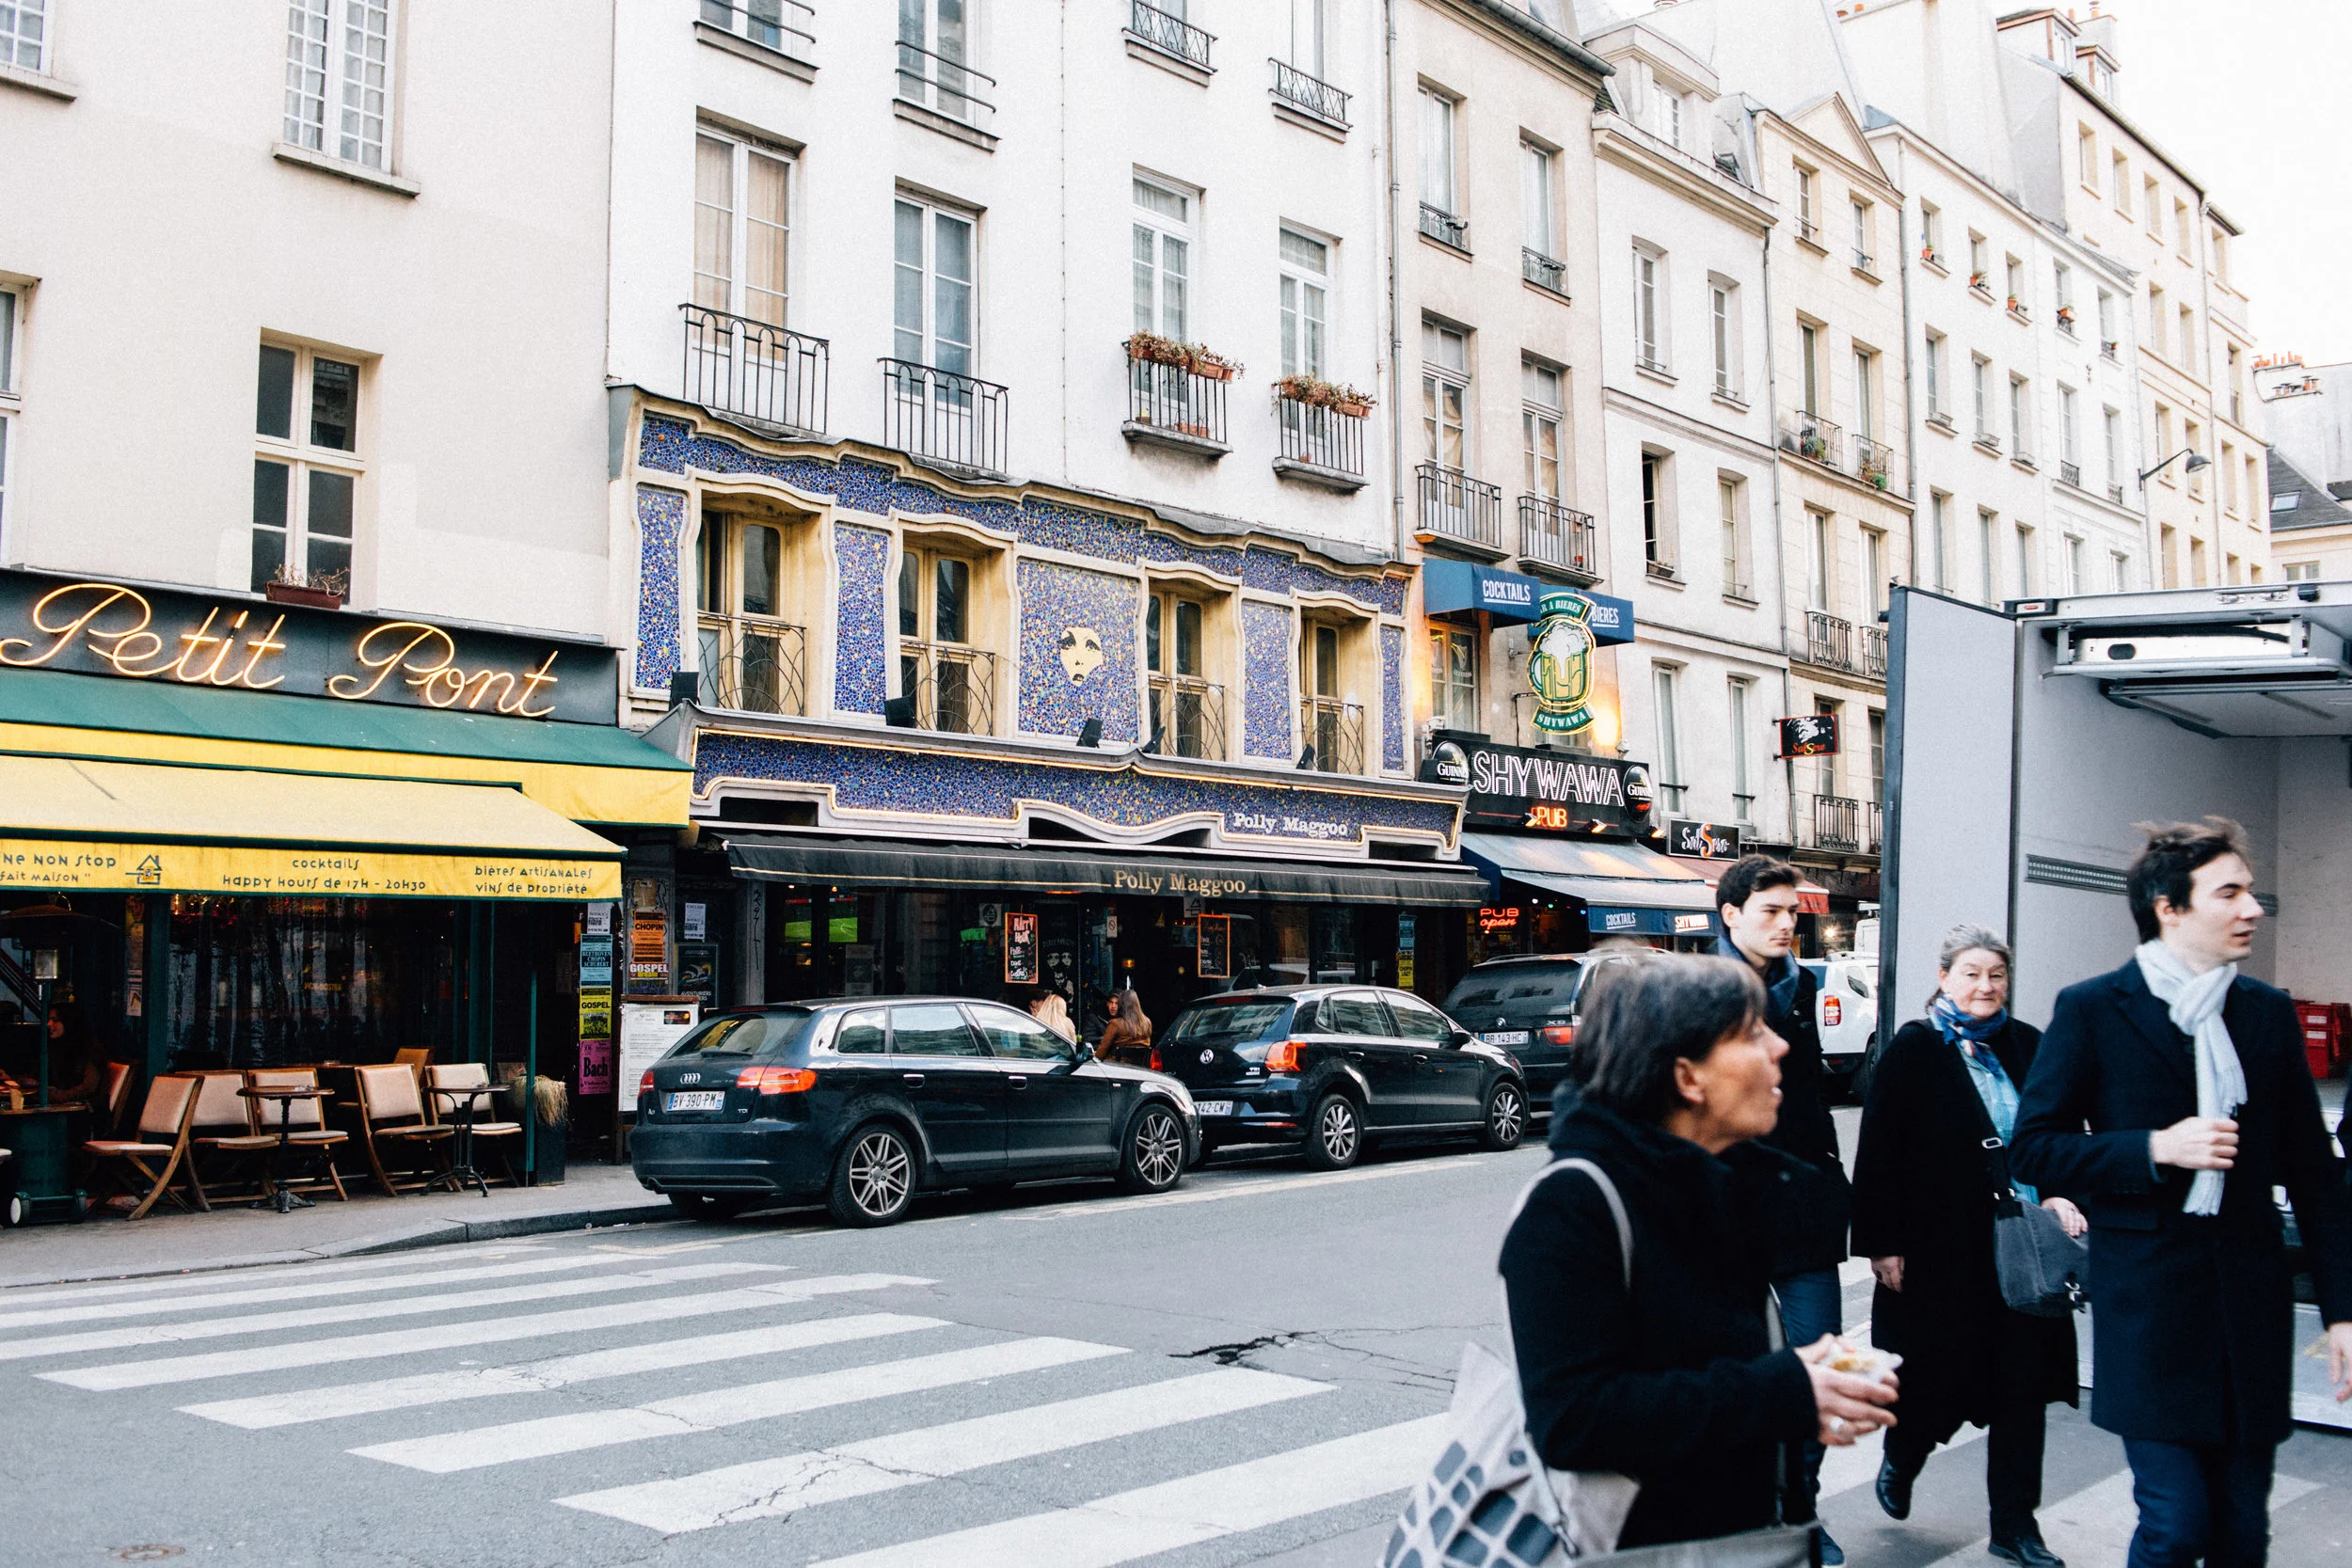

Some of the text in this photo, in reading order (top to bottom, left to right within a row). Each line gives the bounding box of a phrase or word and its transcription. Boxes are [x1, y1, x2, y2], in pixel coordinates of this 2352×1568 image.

[1483, 579, 1531, 602] COCKTAILS
[1555, 600, 1582, 613] BIERES
[1591, 605, 1619, 625] BIERES
[0, 583, 558, 718] Petit Pont
[1536, 712, 1587, 727] SHYWAWA
[1472, 750, 1625, 807] SHYWAWA
[1533, 805, 1568, 828] PUB
[1233, 813, 1348, 838] Polly Maggoo
[33, 854, 69, 866] NON
[293, 858, 359, 870] cocktails
[324, 878, 342, 889] de
[507, 883, 523, 893] de
[1113, 870, 1247, 897] Polly Maggoo
[1480, 908, 1519, 917] PUB
[1605, 912, 1636, 927] COCKTAILS
[1480, 918, 1517, 930] open
[1675, 914, 1708, 929] SHYWAWA
[629, 964, 669, 973] GOSPEL
[583, 1056, 609, 1077] Bach
[673, 1093, 717, 1109] BV-390-PM
